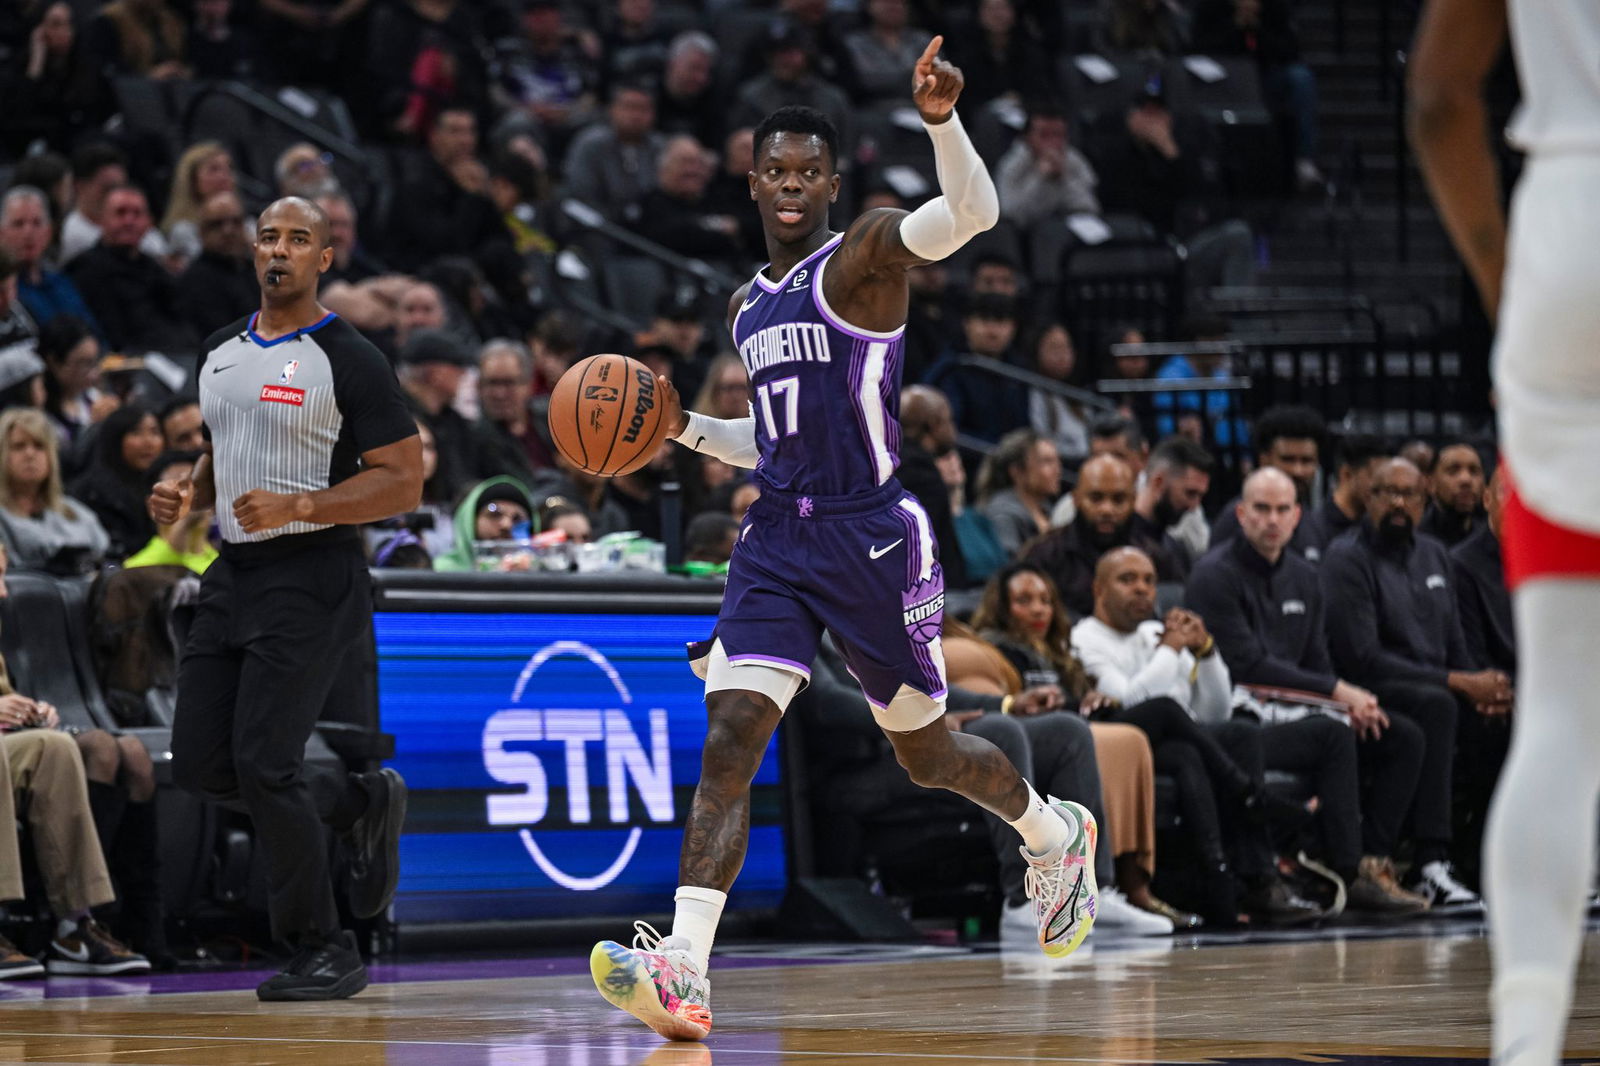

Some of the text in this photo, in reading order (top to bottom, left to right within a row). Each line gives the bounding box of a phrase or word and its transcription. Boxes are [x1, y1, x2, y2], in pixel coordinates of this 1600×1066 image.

[261, 387, 303, 403] Emirates
[622, 368, 655, 444] Wilson
[757, 375, 800, 441] 17
[903, 593, 945, 626] KINGS
[481, 708, 675, 825] STN
